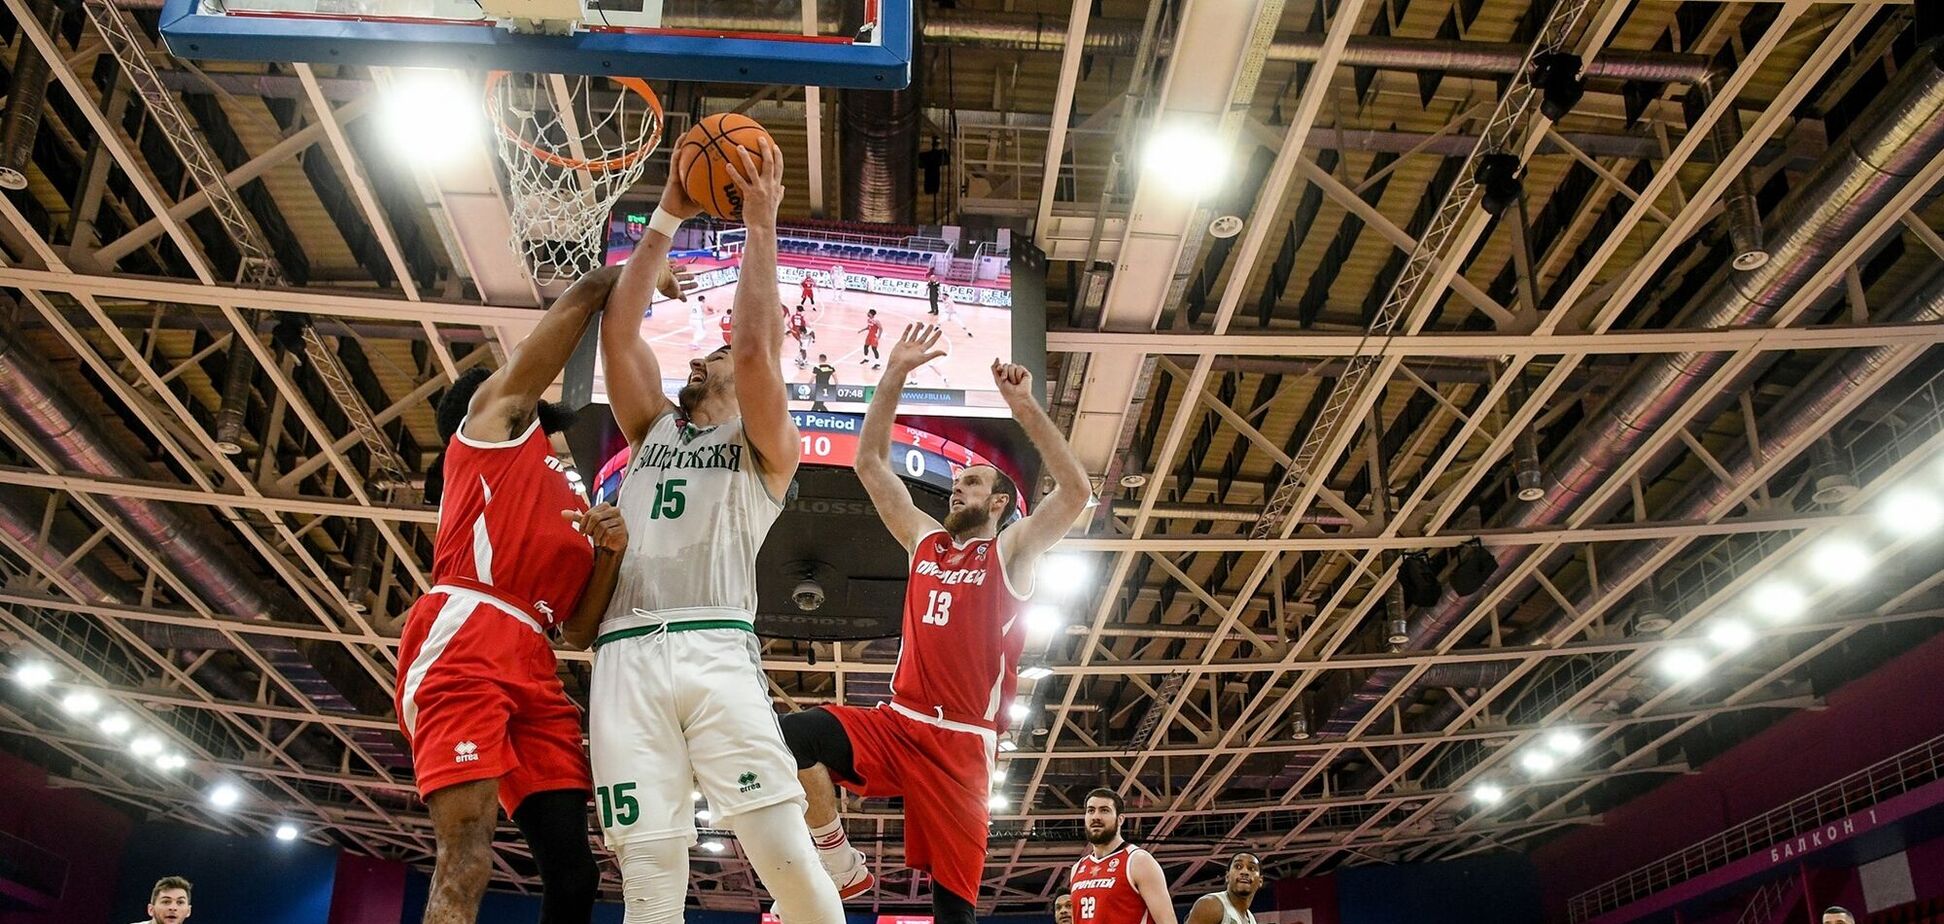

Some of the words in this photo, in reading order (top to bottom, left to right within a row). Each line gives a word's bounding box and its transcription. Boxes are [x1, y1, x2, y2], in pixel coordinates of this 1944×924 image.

[844, 275, 868, 283] PER
[882, 279, 919, 289] ELPER
[823, 388, 829, 397] 1
[837, 388, 864, 399] 07:48
[806, 414, 855, 430] Period
[800, 435, 831, 457] 10
[911, 435, 921, 447] 2
[905, 449, 926, 477] 0
[650, 479, 687, 520] 15
[921, 589, 953, 627] 13
[597, 781, 640, 829] 15
[1770, 818, 1854, 863] БАЛКОН
[1868, 809, 1878, 825] 1
[1080, 896, 1096, 919] 22
